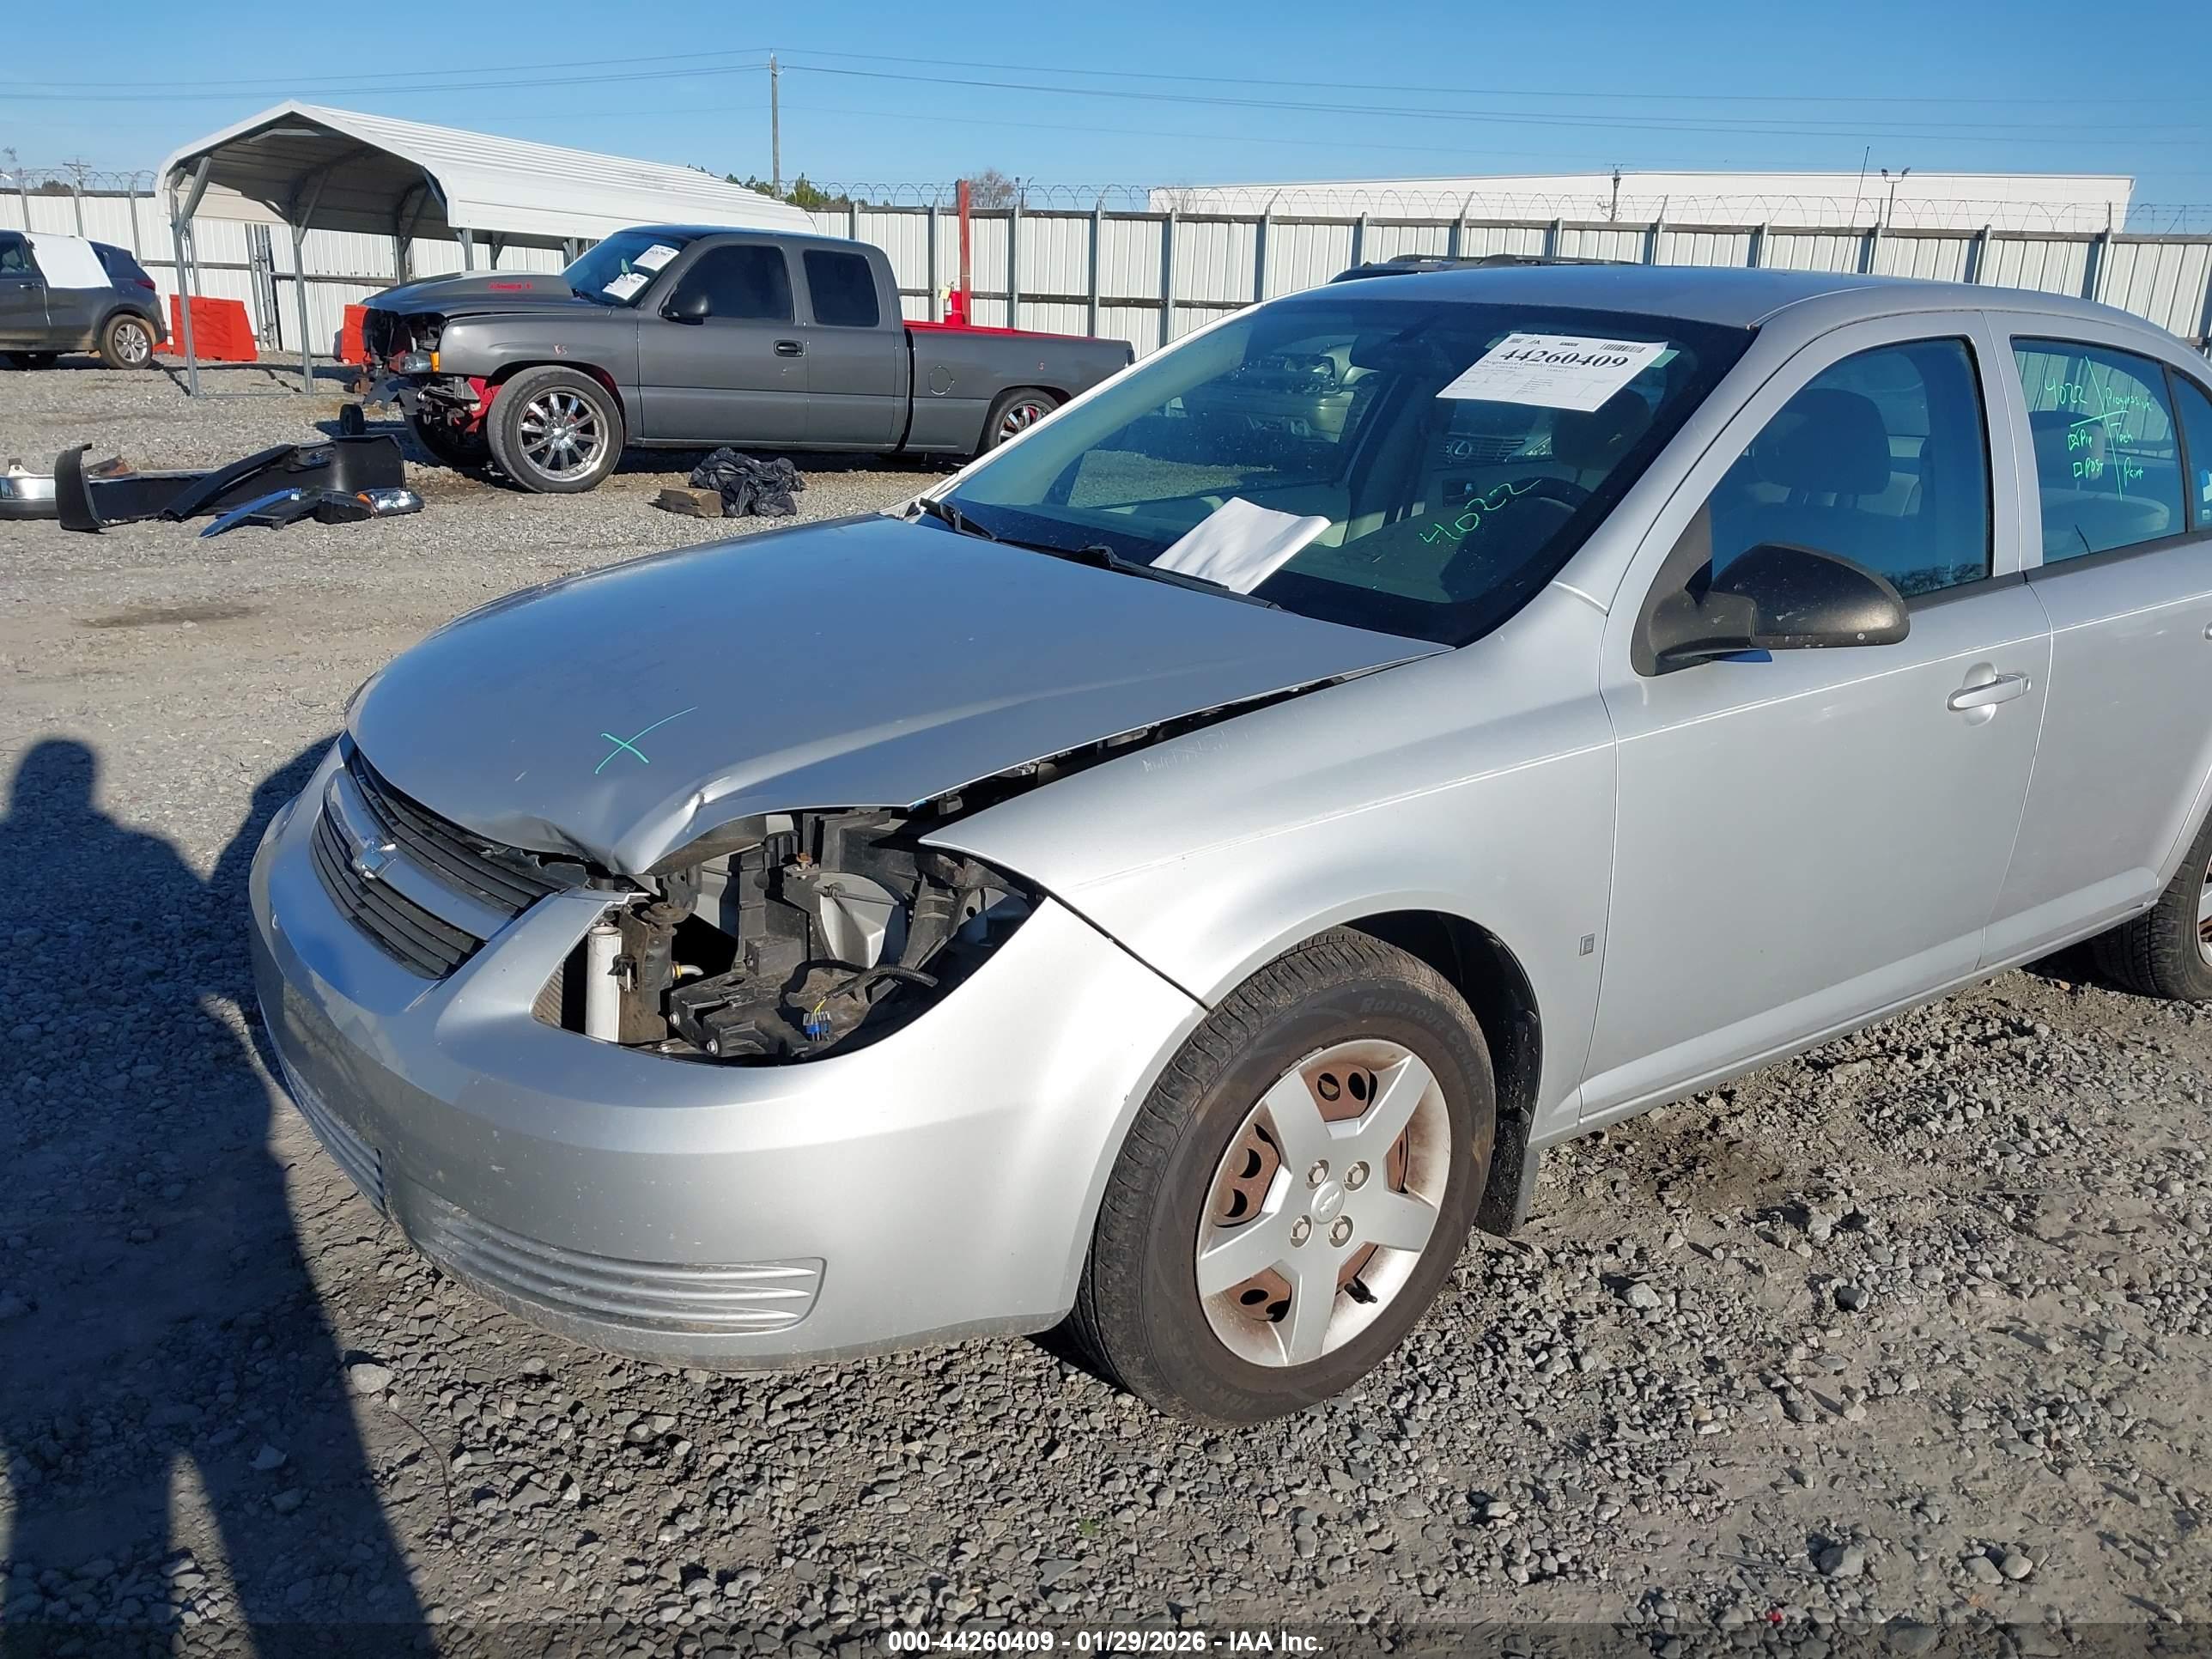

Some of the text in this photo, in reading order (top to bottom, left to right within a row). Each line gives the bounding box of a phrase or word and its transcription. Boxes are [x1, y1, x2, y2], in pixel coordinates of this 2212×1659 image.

[1500, 348, 1629, 368] 44260409
[2045, 377, 2087, 404] 4022
[1419, 478, 1542, 543] 4022
